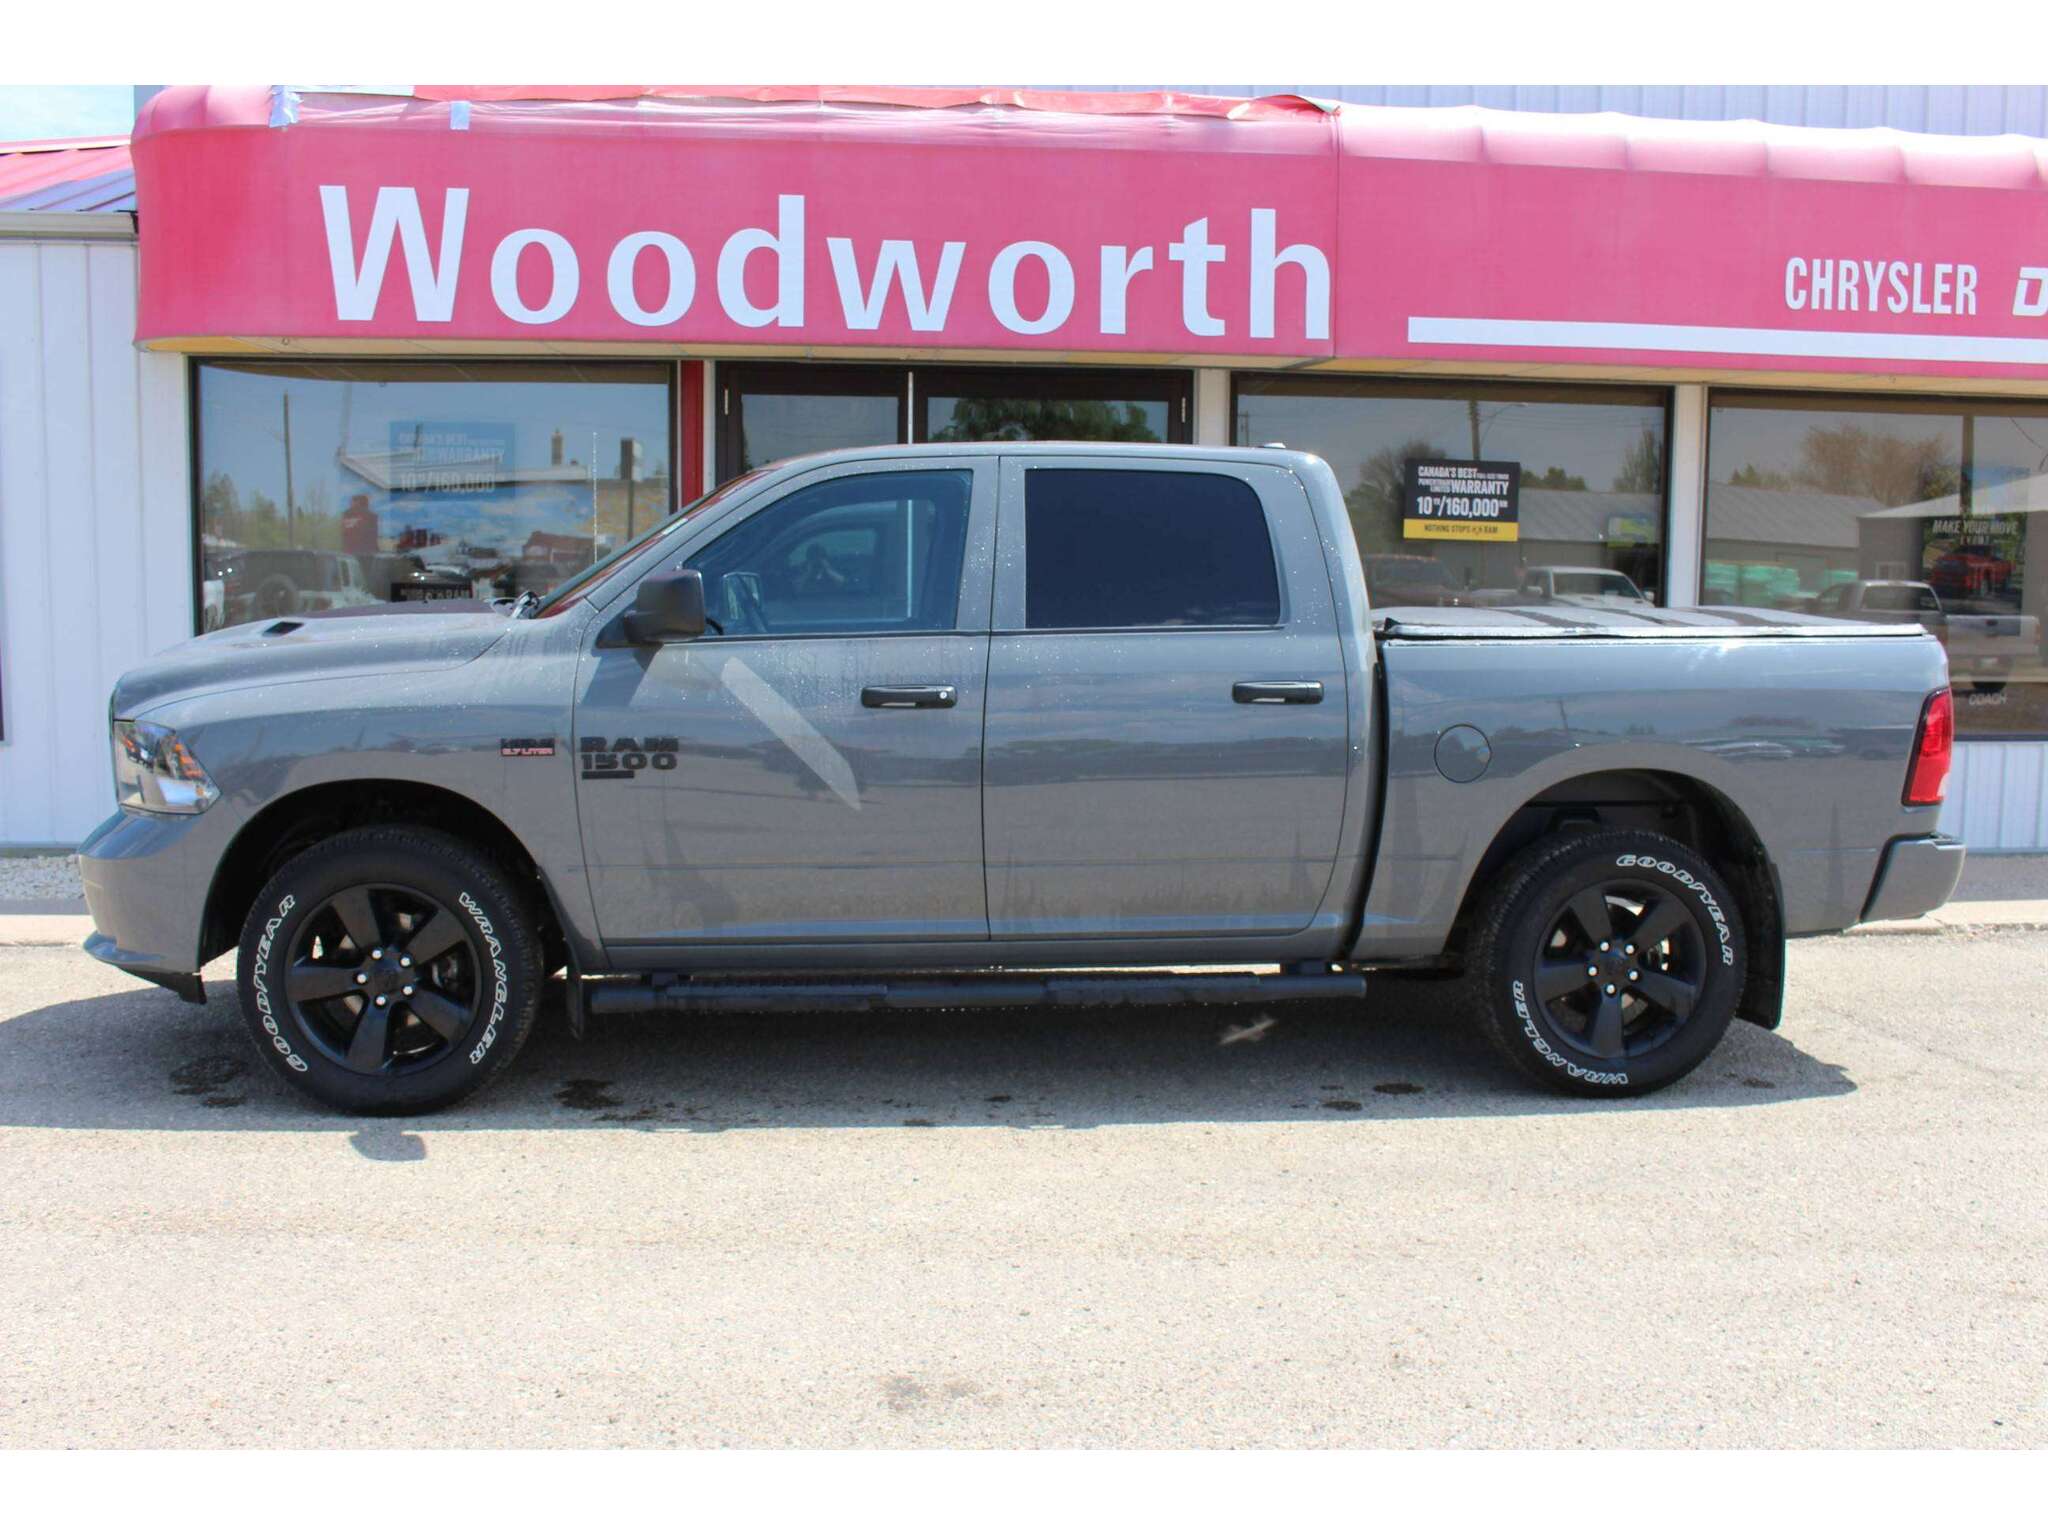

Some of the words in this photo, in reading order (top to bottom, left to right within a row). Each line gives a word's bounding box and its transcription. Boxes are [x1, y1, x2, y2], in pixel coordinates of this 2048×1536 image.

[320, 186, 1331, 339] Woodworth
[1785, 257, 1977, 315] CHRYSLER
[1417, 466, 1456, 478] CANADA'S
[1458, 467, 1478, 479] BEST
[1451, 479, 1509, 495] WARRANTY
[1932, 519, 1960, 534] MAKE
[1962, 519, 1988, 534] YOUR
[580, 736, 679, 752] RAM
[580, 752, 678, 770] 1500
[1615, 854, 1735, 967] GOODYEAR
[254, 894, 308, 1072] GOODYEAR
[457, 891, 508, 1065] WRANGLER
[1512, 979, 1629, 1085] WRANGLER
